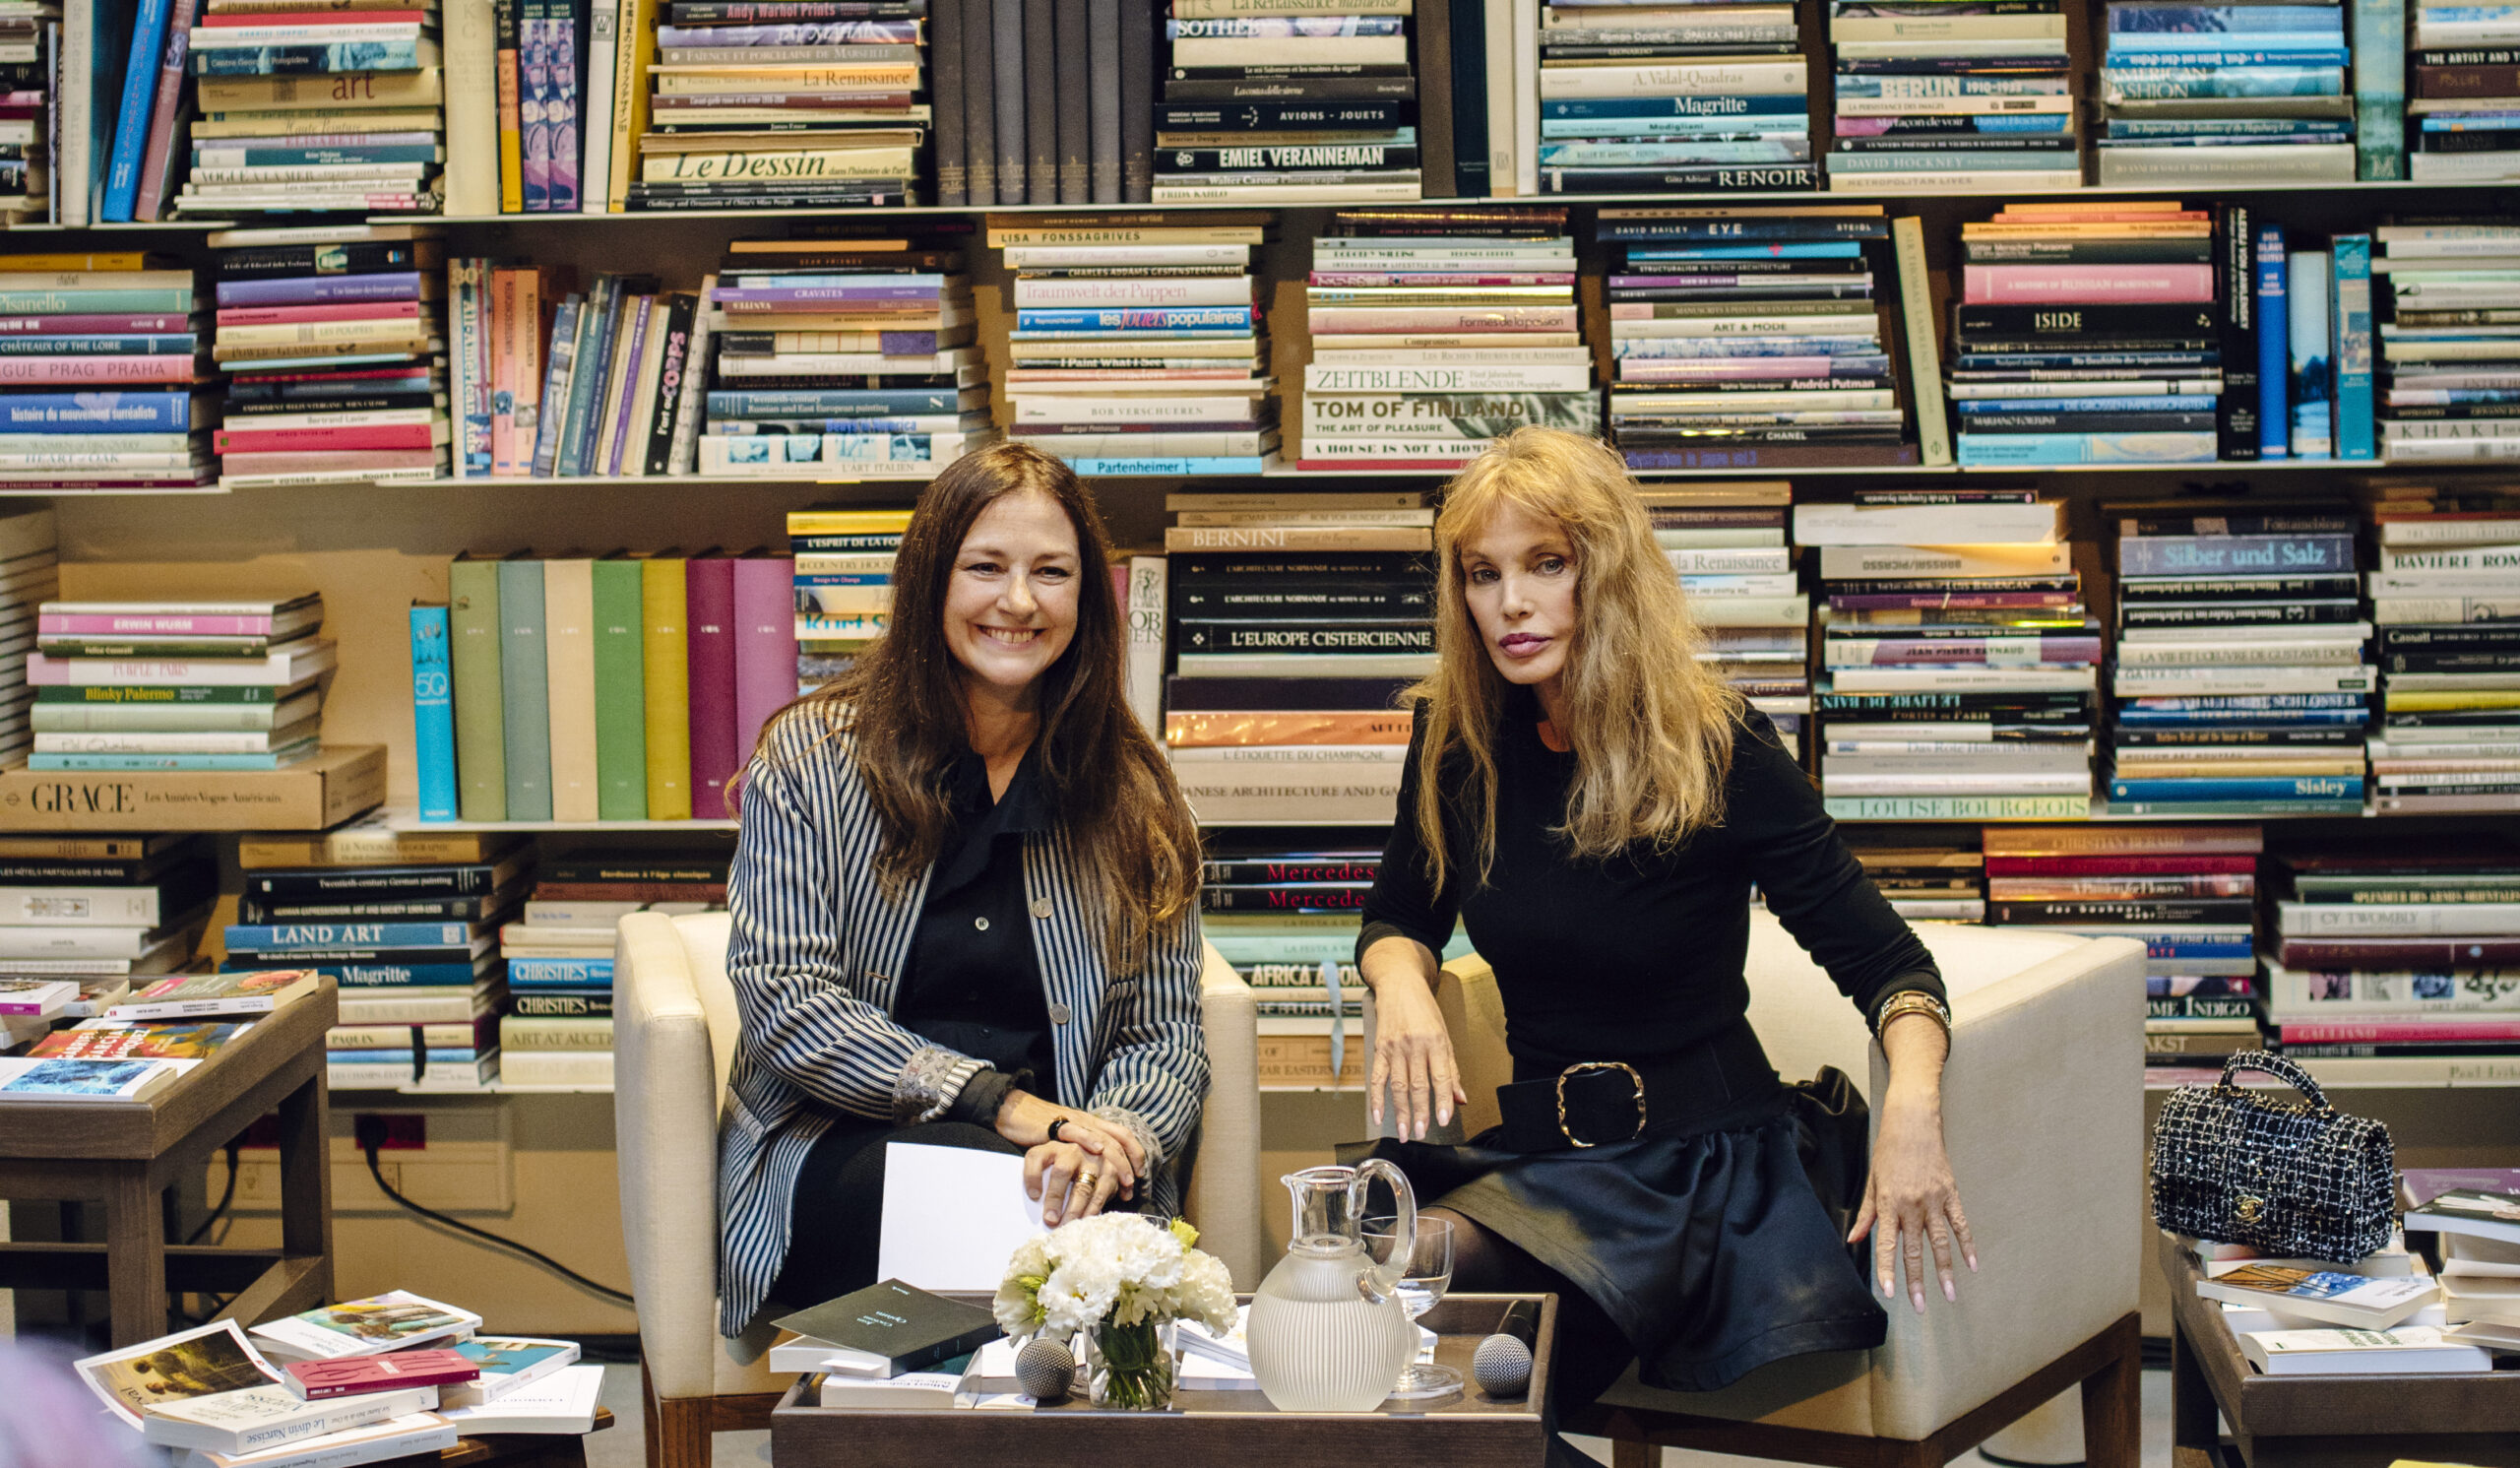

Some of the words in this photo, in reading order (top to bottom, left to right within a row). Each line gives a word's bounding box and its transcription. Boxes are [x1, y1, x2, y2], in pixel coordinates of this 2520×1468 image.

[726, 4, 756, 21] Andy
[758, 3, 798, 19] Warhol
[799, 3, 837, 18] Prints
[833, 46, 891, 59] MARSEILLE
[2425, 53, 2445, 65] THE
[2448, 52, 2486, 64] ARTIST
[2488, 51, 2511, 63] AND
[271, 55, 309, 67] Pompidou
[331, 71, 375, 100] art
[803, 72, 821, 87] La
[825, 70, 911, 86] Renaissance
[1648, 69, 1745, 90] Vidal-Quadras
[1880, 77, 1960, 98] BERLIN
[1673, 96, 1748, 115] Magritte
[1280, 110, 1324, 120] AVIONS
[1339, 109, 1385, 119] JOUETS
[68, 103, 83, 166] Marilyn
[1648, 122, 1704, 133] Modigliani
[1219, 148, 1267, 166] EMIEL
[1269, 146, 1385, 166] VERANNEMAN
[1847, 158, 1889, 170] DAVID
[1893, 157, 1964, 169] HOCKNEY
[673, 153, 715, 180] Le
[721, 150, 828, 178] Dessin
[828, 167, 847, 177] dans
[1209, 175, 1242, 185] Walter
[1718, 169, 1812, 187] RENOIR
[1848, 179, 1930, 190] METROPOLITAN
[1933, 177, 1973, 187] LIVES
[1615, 225, 1648, 236] DAVID
[1651, 225, 1690, 235] BAILEY
[1708, 223, 1744, 236] EYE
[1835, 222, 1872, 233] STEIDL
[1000, 233, 1030, 243] LISA
[1041, 231, 1142, 243] FONSSAGRIVES
[1068, 267, 1109, 278] CHARLES
[1110, 266, 1149, 277] ADDAMS
[1151, 265, 1243, 276] GESPENSTERPARADE
[1639, 264, 1699, 274] STRUCTURALISM
[1710, 263, 1736, 273] DUTCH
[1737, 262, 1792, 272] ARCHITECTURE
[794, 287, 844, 299] CRAVATES
[1024, 283, 1101, 300] Traumwelt
[1102, 283, 1126, 299] der
[1130, 283, 1187, 305] Puppen
[1167, 310, 1245, 331] populaires
[1713, 322, 1738, 333] ART
[1740, 322, 1749, 332] &
[1752, 321, 1788, 332] MODE
[2035, 312, 2083, 329] ISIDE
[0, 340, 53, 352] CHÂTEAUX
[55, 340, 69, 352] OF
[71, 340, 91, 352] THE
[93, 339, 122, 352] LOIRE
[1404, 337, 1462, 350] Compromises
[462, 300, 478, 415] All-American
[49, 363, 95, 379] PRAG
[107, 362, 166, 379] PRAHA
[1316, 369, 1466, 389] ZEITBLENDE
[1791, 378, 1831, 391] Andrée
[1832, 378, 1875, 390] Putman
[11, 407, 45, 422] histoire
[45, 407, 58, 421] du
[59, 408, 110, 422] mouvement
[111, 405, 158, 420] surréaliste
[1091, 408, 1115, 416] BOB
[1118, 407, 1204, 416] VERSCHUEREN
[1311, 401, 1366, 417] TOM
[1372, 400, 1406, 417] OF
[1413, 400, 1526, 418] FINLAND
[1315, 423, 1337, 433] THE
[1340, 423, 1363, 433] ART
[1366, 423, 1382, 433] OF
[1385, 422, 1445, 433] PLEASURE
[2402, 422, 2501, 439] KHAKI
[464, 419, 482, 455] Ads
[1766, 430, 1808, 441] CHANEL
[1312, 444, 1322, 454] A
[1328, 444, 1377, 454] HOUSE
[1383, 444, 1399, 454] IS
[1403, 444, 1428, 454] NOT
[1437, 443, 1448, 454] A
[842, 464, 872, 475] L'ART
[875, 463, 915, 474] ITALIEN
[1097, 461, 1180, 475] Partenheimer
[2263, 516, 2347, 532] Fontainebleau
[807, 538, 850, 548] L'ESPRIT
[851, 538, 865, 548] DE
[867, 537, 882, 547] LA
[1192, 530, 1289, 547] BERNINI
[2164, 543, 2226, 568] Silber
[2231, 542, 2277, 567] und
[2280, 541, 2327, 566] Salz
[1287, 563, 1328, 573] NORMANDE
[1694, 554, 1782, 572] Renaissance
[1224, 595, 1284, 604] L'ARCHITECTURE
[1285, 595, 1328, 604] NORMANDE
[113, 618, 153, 630] ERWIN
[155, 618, 193, 630] WURM
[1230, 631, 1310, 647] L'EUROPE
[1311, 631, 1431, 647] CISTERCIENNE
[2388, 631, 2431, 644] Cassatt
[1905, 646, 1934, 657] JEAN
[1935, 645, 1972, 657] PIERRE
[1974, 645, 2025, 657] RAYNAUD
[2140, 651, 2158, 664] LA
[2160, 651, 2178, 664] VIE
[2269, 649, 2319, 662] GUSTAVE
[112, 662, 154, 678] PURPLE
[158, 662, 190, 678] PARIS
[415, 670, 448, 697] 50
[85, 686, 123, 704] Blinky
[124, 687, 175, 701] Palermo
[1822, 694, 1860, 710] BAIN
[1864, 694, 1887, 709] DU
[1889, 694, 1937, 709] LIVRE
[1940, 693, 1962, 709] LE
[1954, 710, 1991, 721] PARIS
[1300, 750, 1314, 761] DU
[1316, 749, 1386, 761] CHAMPAGNE
[1233, 785, 1340, 798] ARCHITECTURE
[1343, 785, 1376, 798] AND
[2294, 779, 2348, 798] Sisley
[31, 783, 136, 814] GRACE
[1859, 799, 1946, 819] LOUISE
[1950, 798, 2087, 818] BOURGEOIS
[42, 867, 92, 877] PARTICULIERS
[103, 866, 125, 877] PARIS
[1267, 862, 1376, 881] Mercedes
[319, 877, 387, 890] Twentieth-century
[389, 876, 418, 887] German
[420, 875, 453, 887] painting
[2319, 912, 2343, 925] CY
[2346, 911, 2420, 926] TWOMBLY
[272, 925, 334, 944] LAND
[342, 925, 383, 945] ART
[342, 965, 412, 988] Magritte
[1250, 964, 1312, 988] AFRICA
[2184, 994, 2252, 1018] INDIGO
[331, 1033, 374, 1047] PAQUIN
[511, 1032, 540, 1046] ART
[542, 1032, 563, 1046] AT
[2297, 1027, 2377, 1042] GALLIANO
[287, 1420, 311, 1436] divin
[310, 1417, 326, 1433] Le
[246, 1425, 287, 1444] Narcisse
